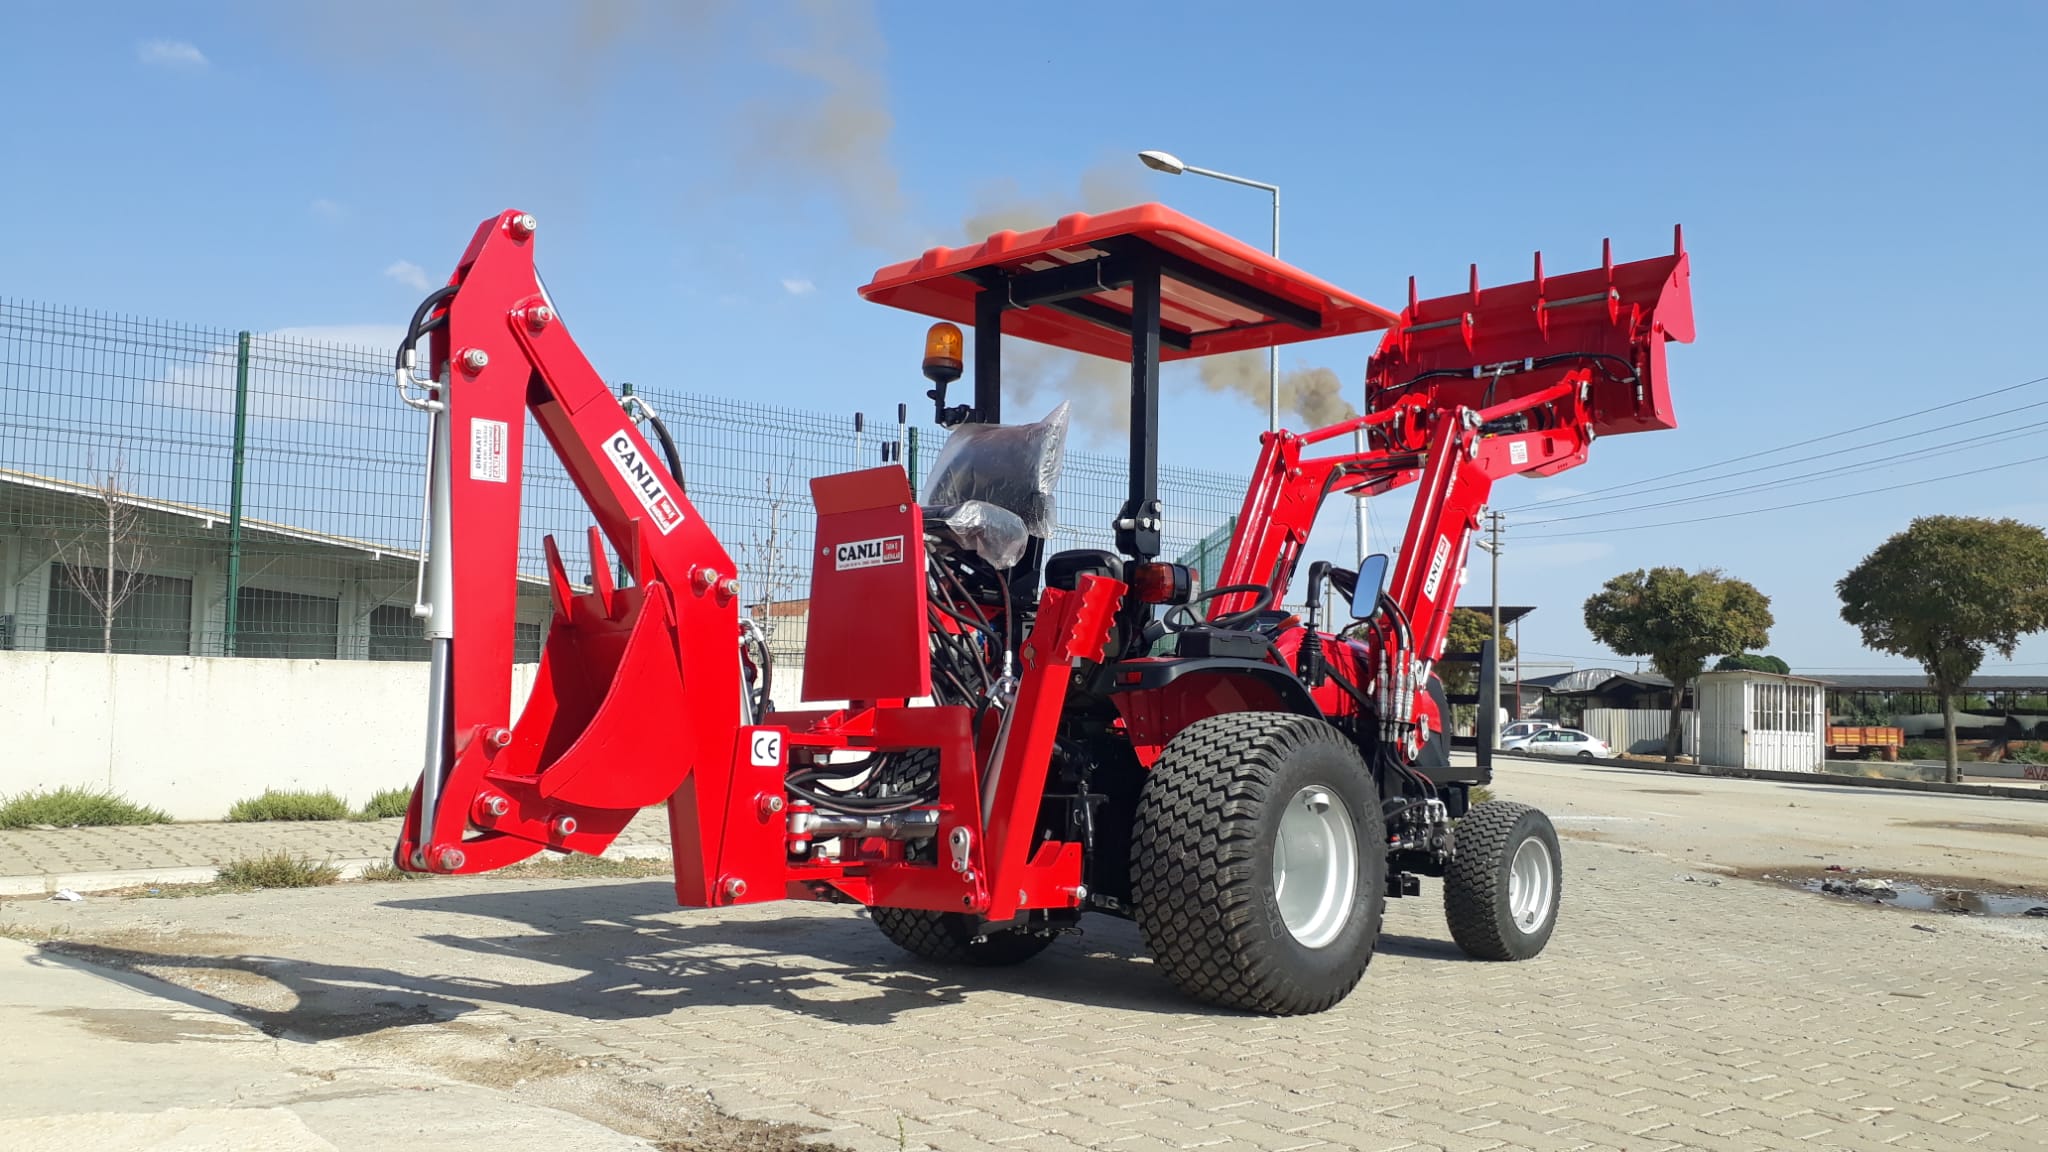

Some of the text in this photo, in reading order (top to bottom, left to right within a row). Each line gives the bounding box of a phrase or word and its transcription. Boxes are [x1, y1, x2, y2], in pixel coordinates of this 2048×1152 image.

[613, 436, 662, 501] CANLI
[838, 542, 882, 562] CANLI
[1426, 555, 1442, 595] CANLI
[754, 737, 778, 760] CE
